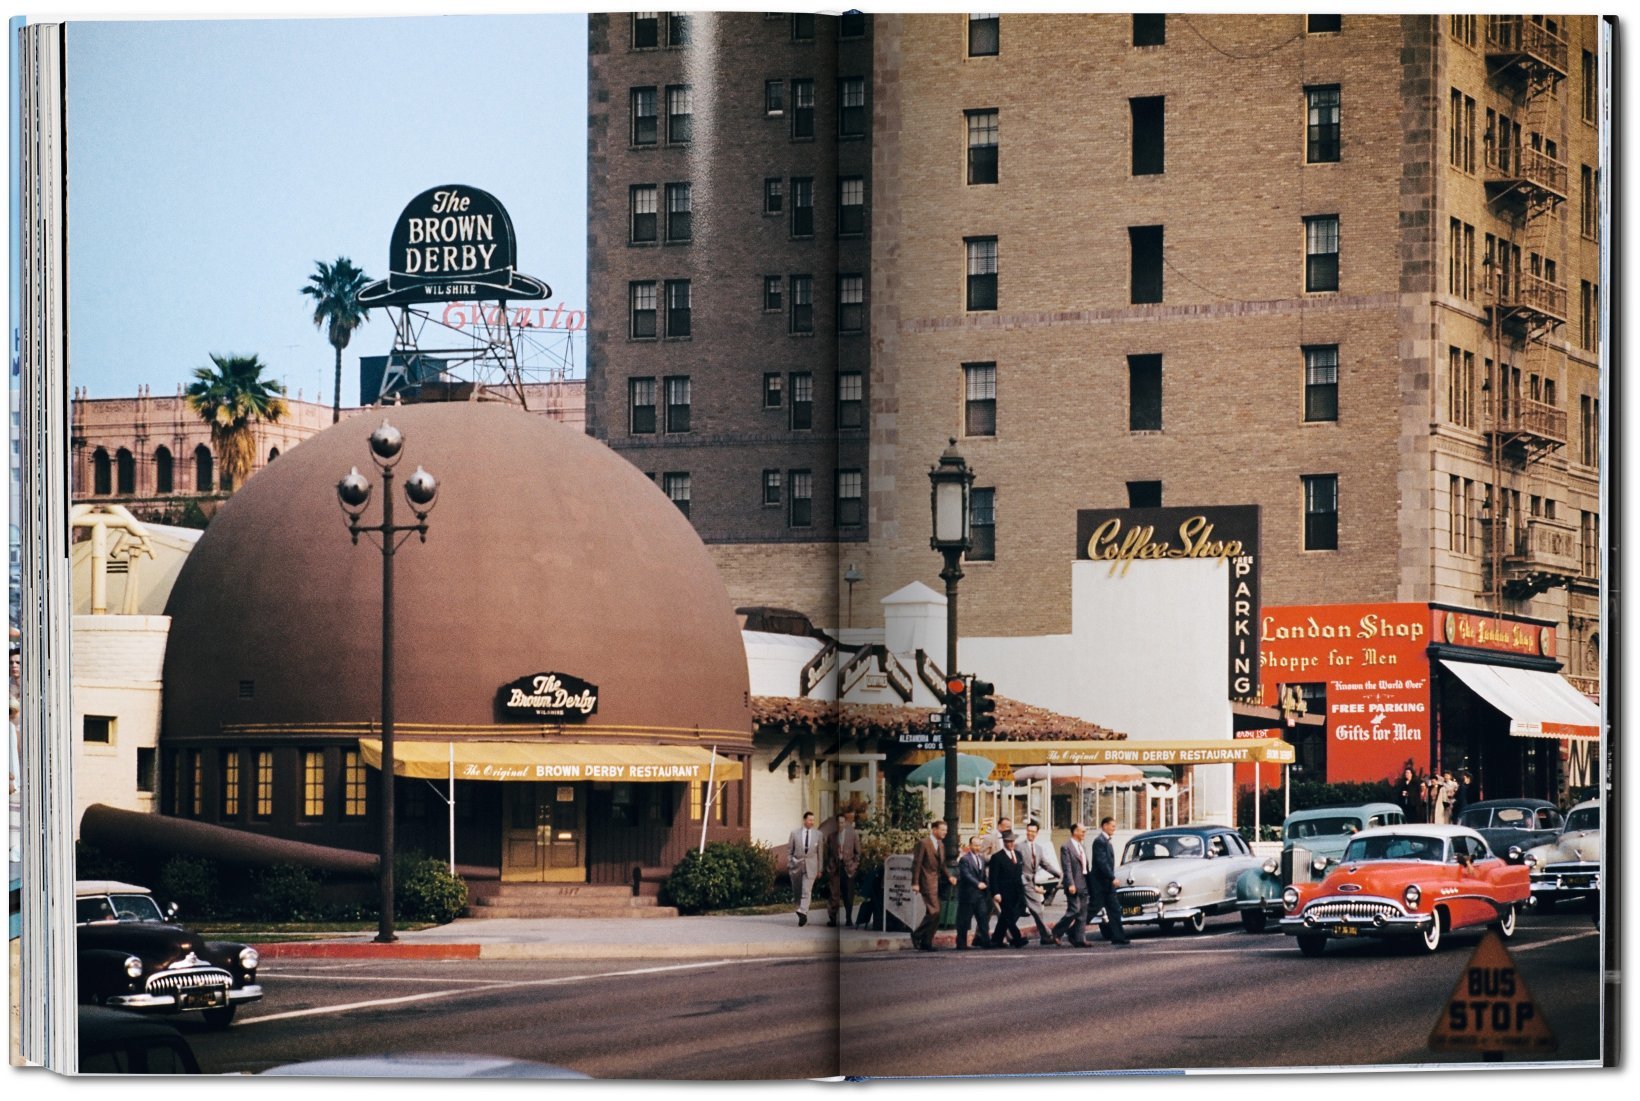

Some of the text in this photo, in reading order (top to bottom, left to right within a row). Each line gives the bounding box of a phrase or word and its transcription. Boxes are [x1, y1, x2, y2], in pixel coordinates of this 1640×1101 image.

[431, 190, 471, 213] The
[408, 214, 494, 244] BROWN
[405, 243, 497, 274] DERBY
[424, 284, 477, 295] WILSHIRE
[1087, 516, 1243, 578] Coffee Shop
[1234, 563, 1251, 694] PARKING
[1260, 613, 1424, 642] London Shop
[1328, 649, 1354, 666] for
[1361, 648, 1398, 666] Men
[533, 674, 562, 695] The
[1364, 680, 1377, 690] the
[1378, 680, 1404, 690] World
[507, 688, 597, 714] Brown Derby
[1331, 702, 1425, 713] FREE PARKING
[1335, 723, 1422, 744] Gifts for Men
[1104, 751, 1138, 761] BROWN
[1142, 750, 1176, 761] DERBY
[1180, 749, 1249, 761] RESTAURANT
[463, 763, 700, 781] The Original BROWN DERBY RESTAURANT
[1467, 967, 1516, 997] BUS
[1449, 1001, 1535, 1031] STOP
